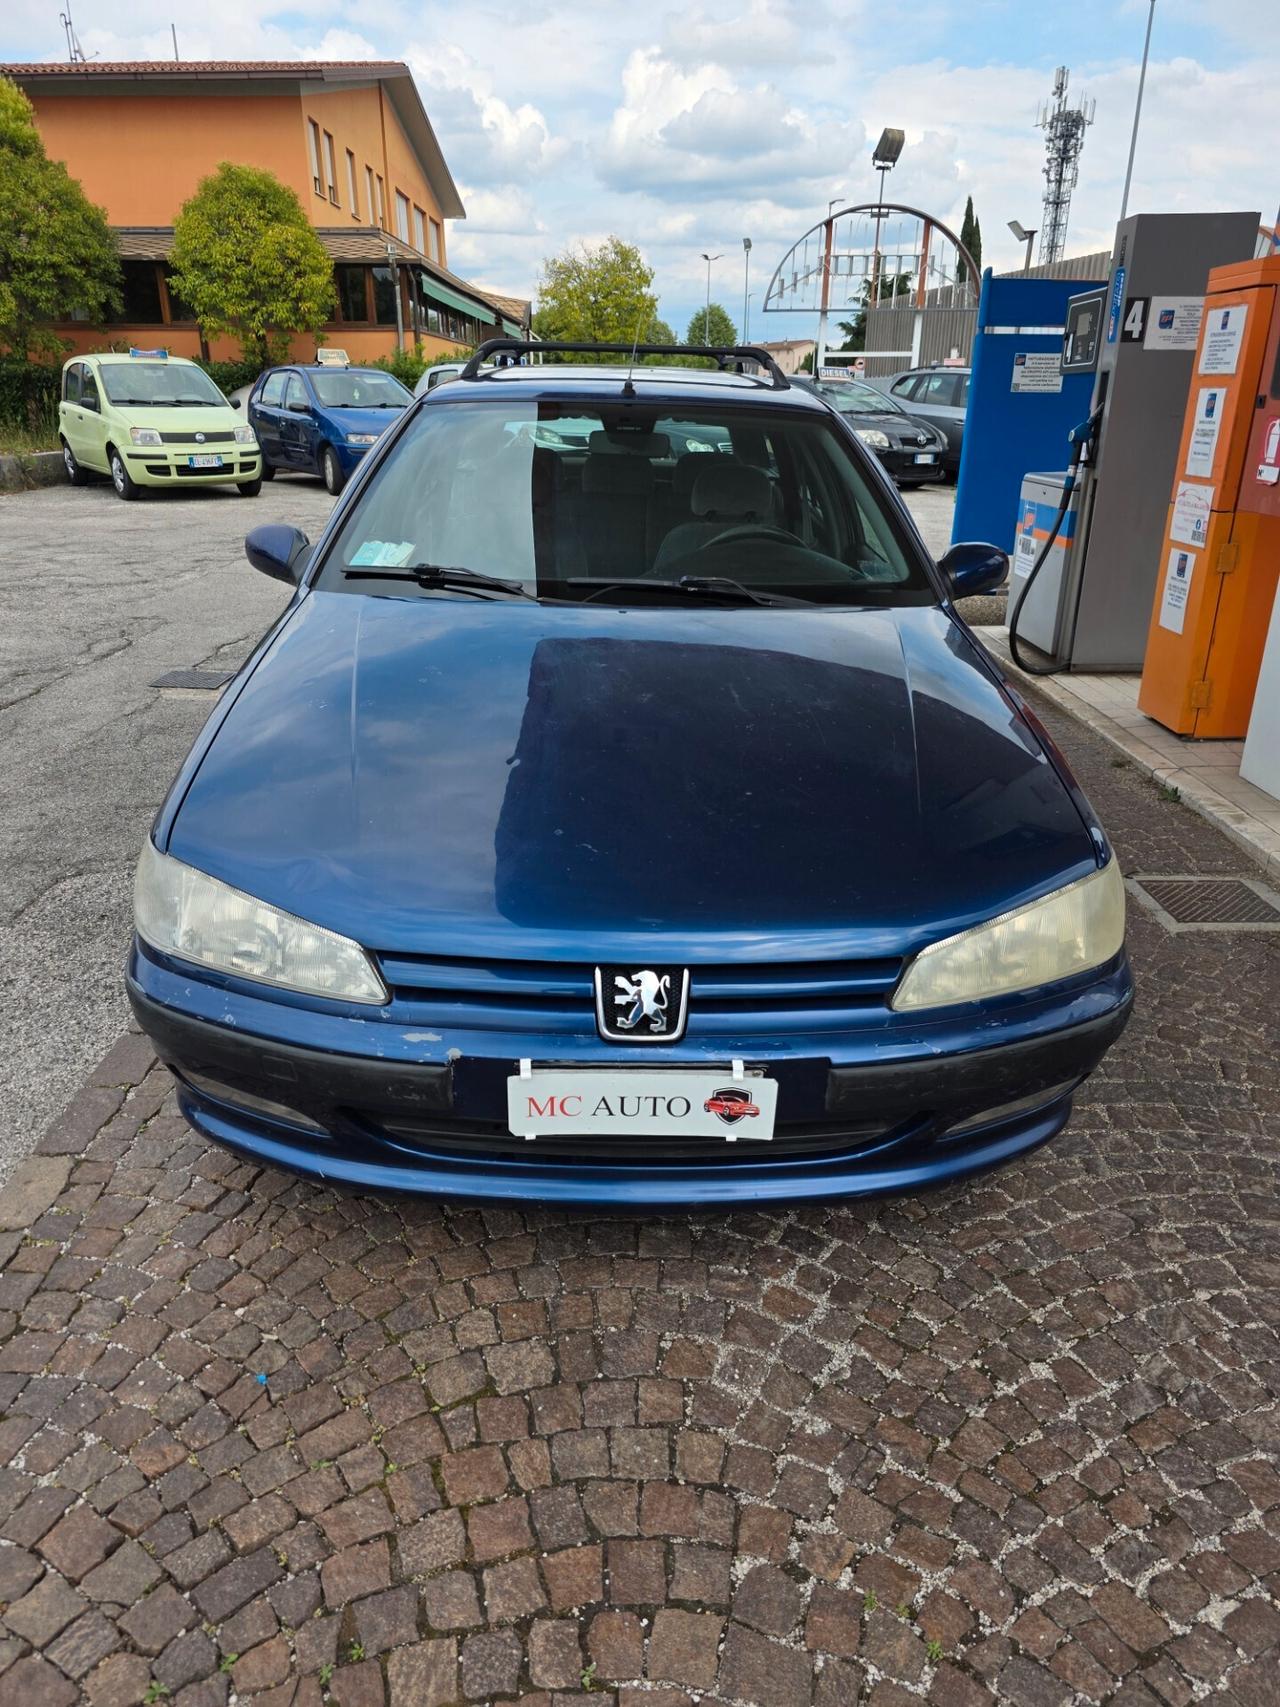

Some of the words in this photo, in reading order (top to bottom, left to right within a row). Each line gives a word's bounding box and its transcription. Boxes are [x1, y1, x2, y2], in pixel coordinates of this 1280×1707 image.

[1124, 300, 1144, 339] 4
[821, 369, 849, 377] DIESEL
[526, 1095, 582, 1118] MC
[591, 1095, 691, 1118] AUTO
